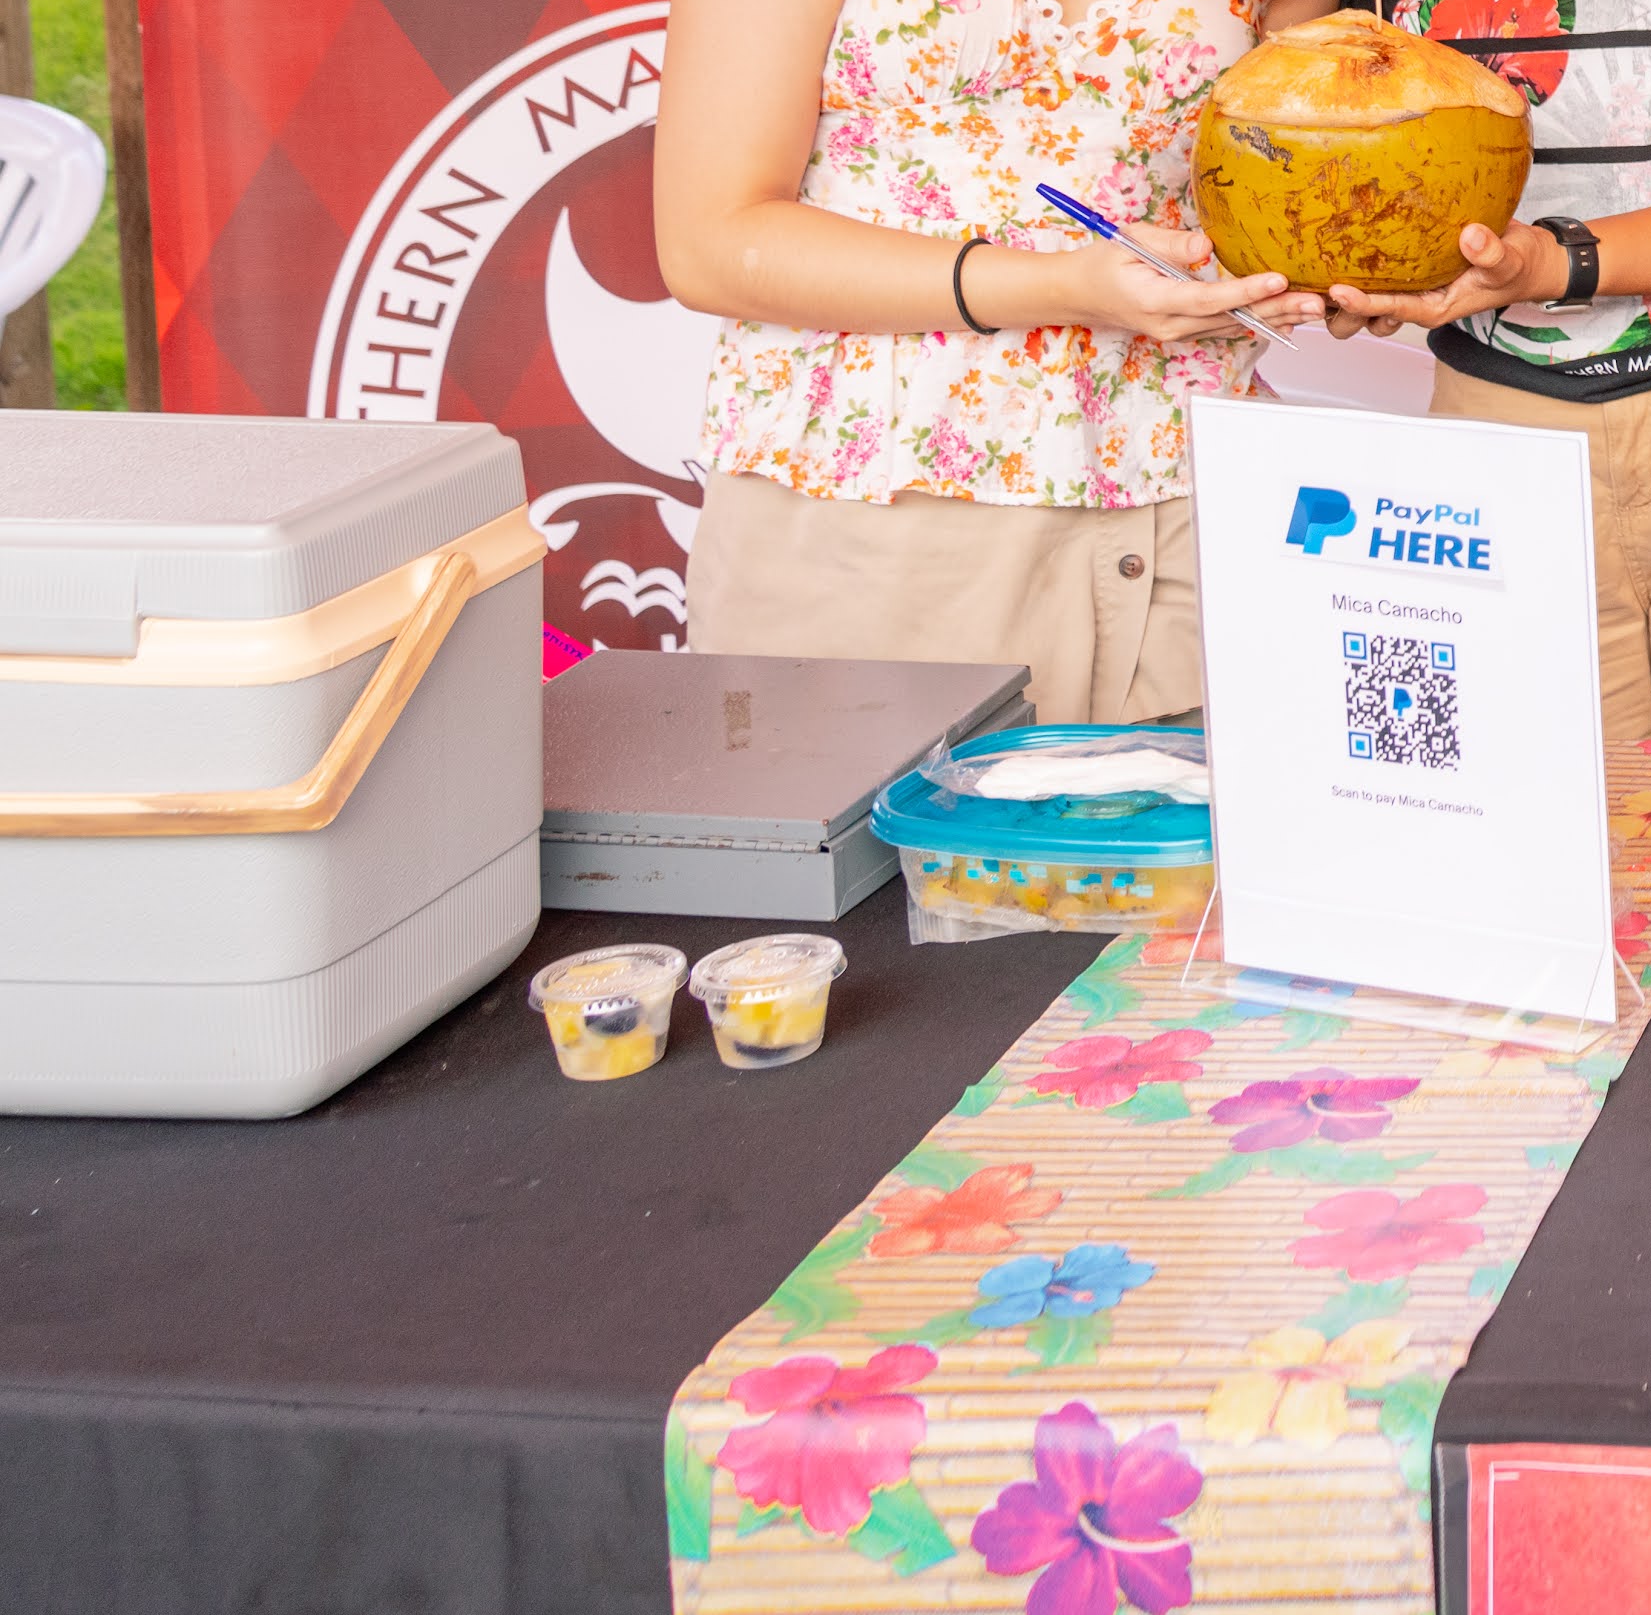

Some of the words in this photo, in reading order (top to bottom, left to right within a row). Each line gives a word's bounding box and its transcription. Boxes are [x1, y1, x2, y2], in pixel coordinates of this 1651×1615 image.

[351, 167, 507, 420] HERN
[1375, 497, 1481, 528] PayPal
[1368, 527, 1491, 571] HERE
[1331, 594, 1373, 613] Mica
[1378, 600, 1463, 624] Camacho
[1331, 785, 1359, 799] Scan
[1362, 789, 1373, 801] to
[1376, 793, 1396, 806] pay
[1399, 795, 1425, 809] Mica
[1428, 799, 1484, 816] Camacho
